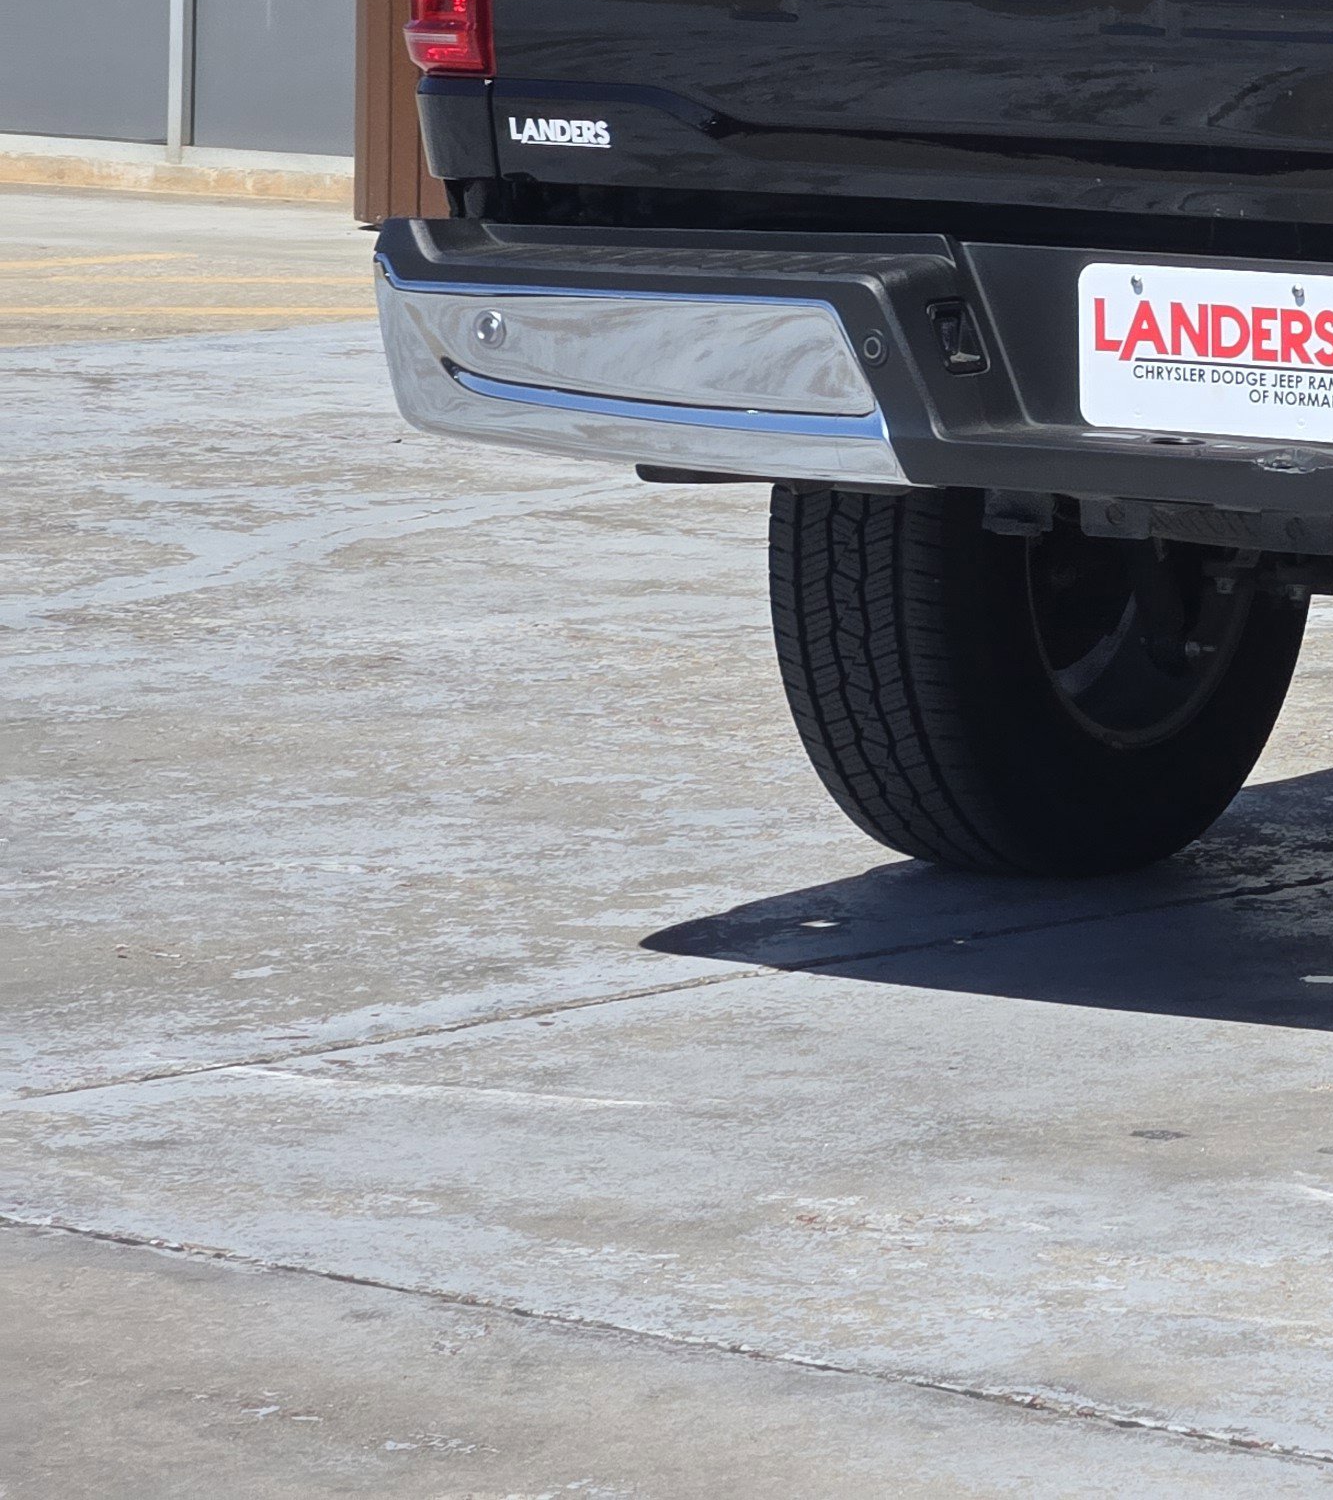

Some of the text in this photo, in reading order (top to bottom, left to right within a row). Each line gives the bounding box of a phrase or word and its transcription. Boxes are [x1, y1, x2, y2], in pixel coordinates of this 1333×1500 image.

[508, 116, 611, 145] LANDERS
[1133, 365, 1206, 384] CHRYSLER
[1211, 369, 1267, 387] DODGE
[1271, 373, 1303, 389] JEEP
[1249, 389, 1269, 404] OF
